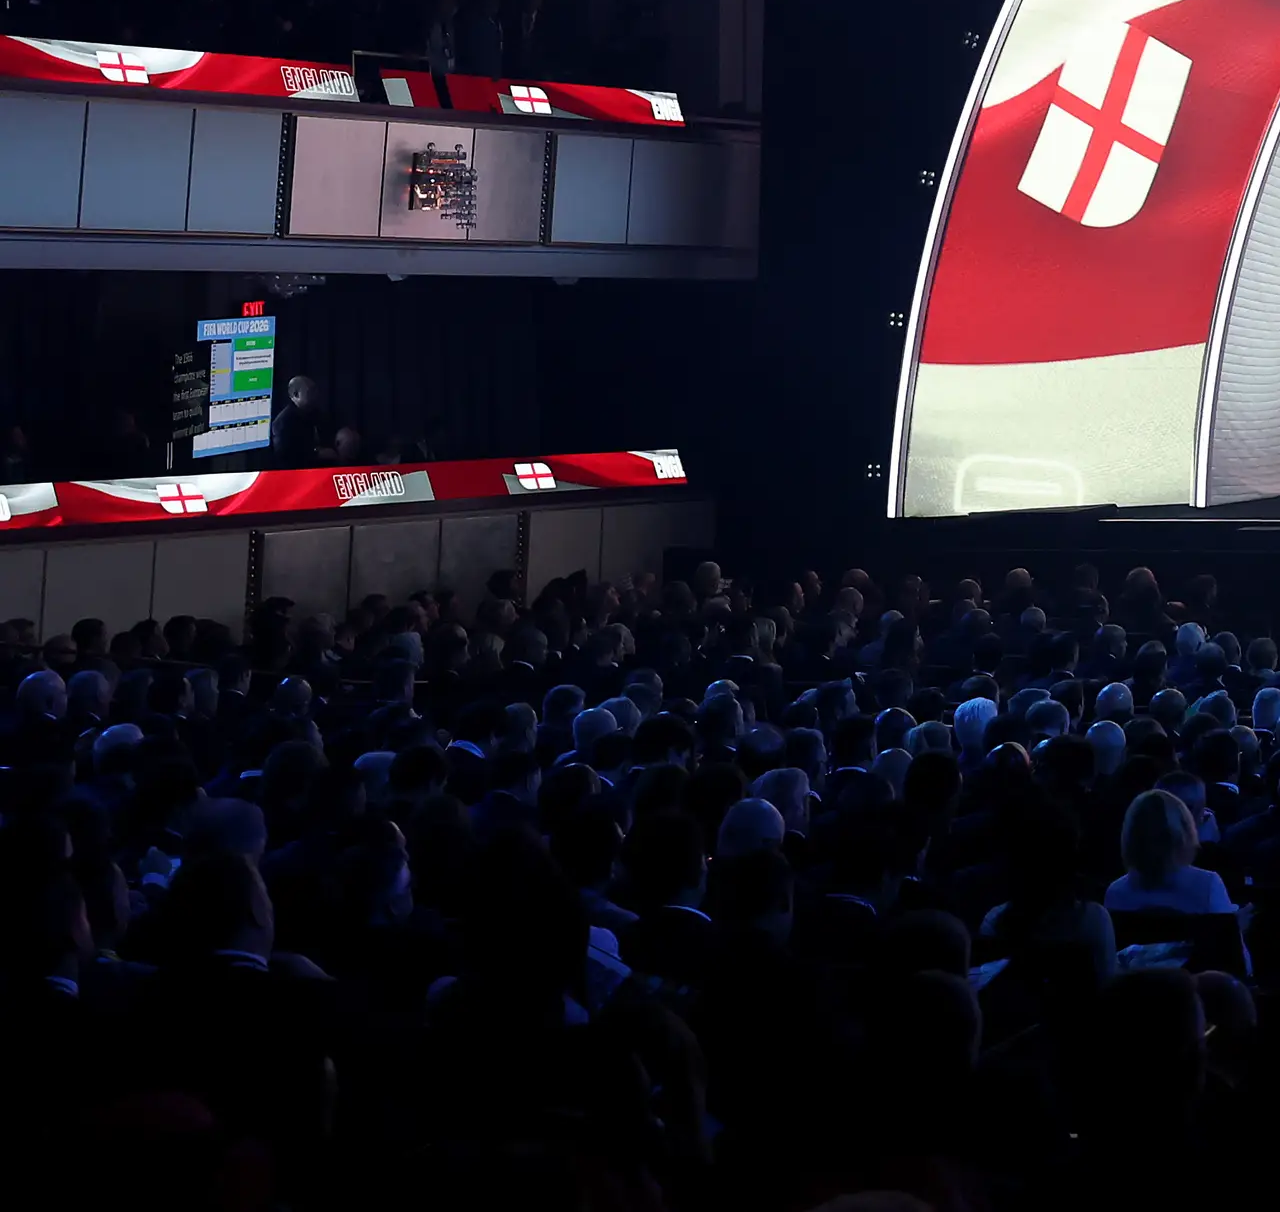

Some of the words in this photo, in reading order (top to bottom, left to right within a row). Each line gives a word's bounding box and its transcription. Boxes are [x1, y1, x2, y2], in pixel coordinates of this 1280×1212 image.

[281, 66, 354, 95] ENGLAND
[242, 300, 265, 316] EXIT
[203, 322, 217, 336] FIFA
[217, 321, 238, 335] WORLD
[238, 320, 250, 334] CUP
[250, 319, 269, 333] 2026
[333, 471, 405, 499] ENGLAND
